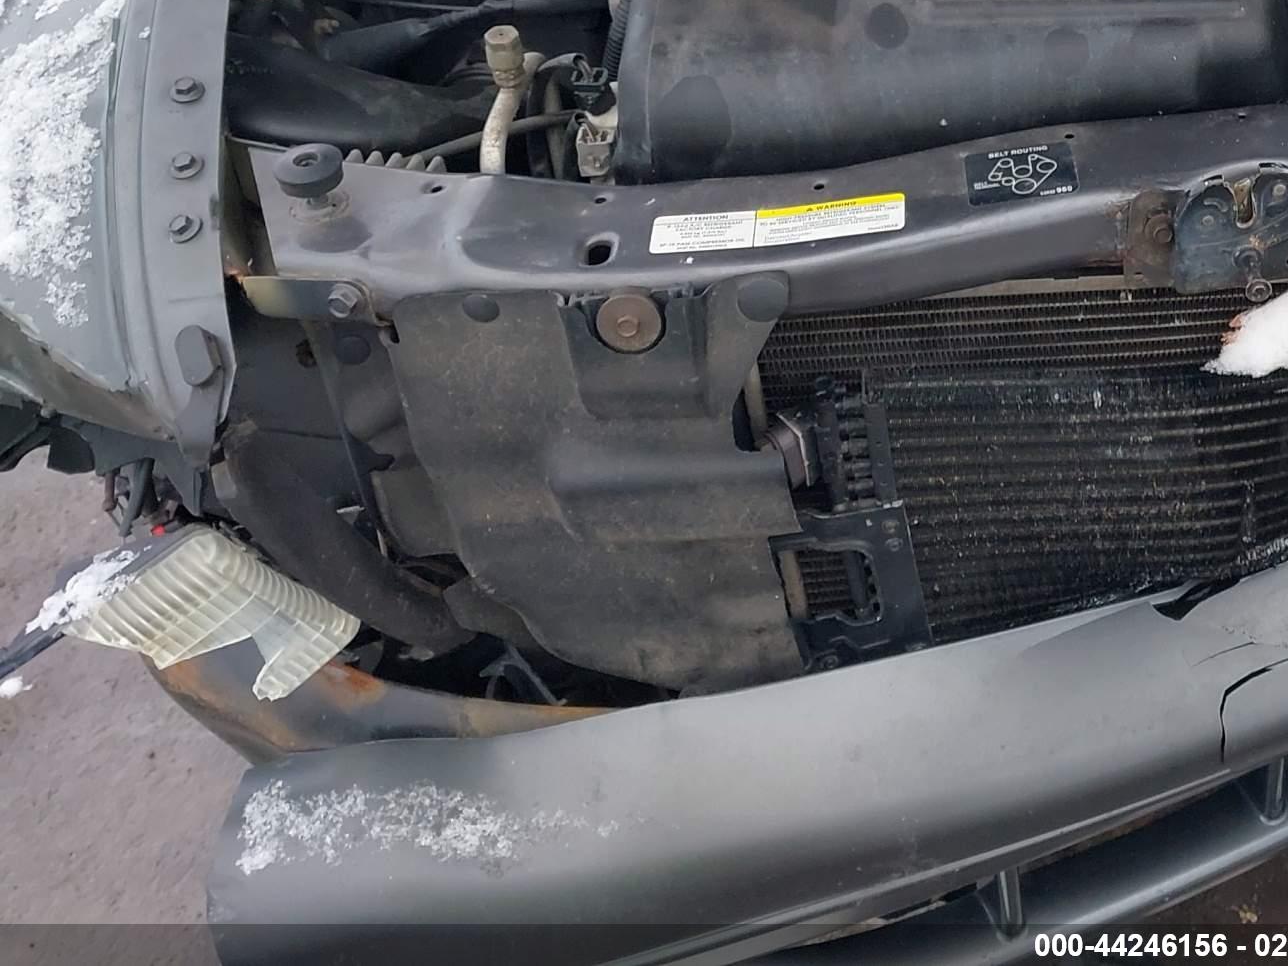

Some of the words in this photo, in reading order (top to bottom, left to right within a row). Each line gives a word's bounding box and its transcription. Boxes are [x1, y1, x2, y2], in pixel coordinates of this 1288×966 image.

[988, 150, 1009, 159] BELT
[1010, 145, 1048, 155] ROUTING
[816, 201, 857, 210] WARNING
[683, 214, 729, 222] ATTENTION
